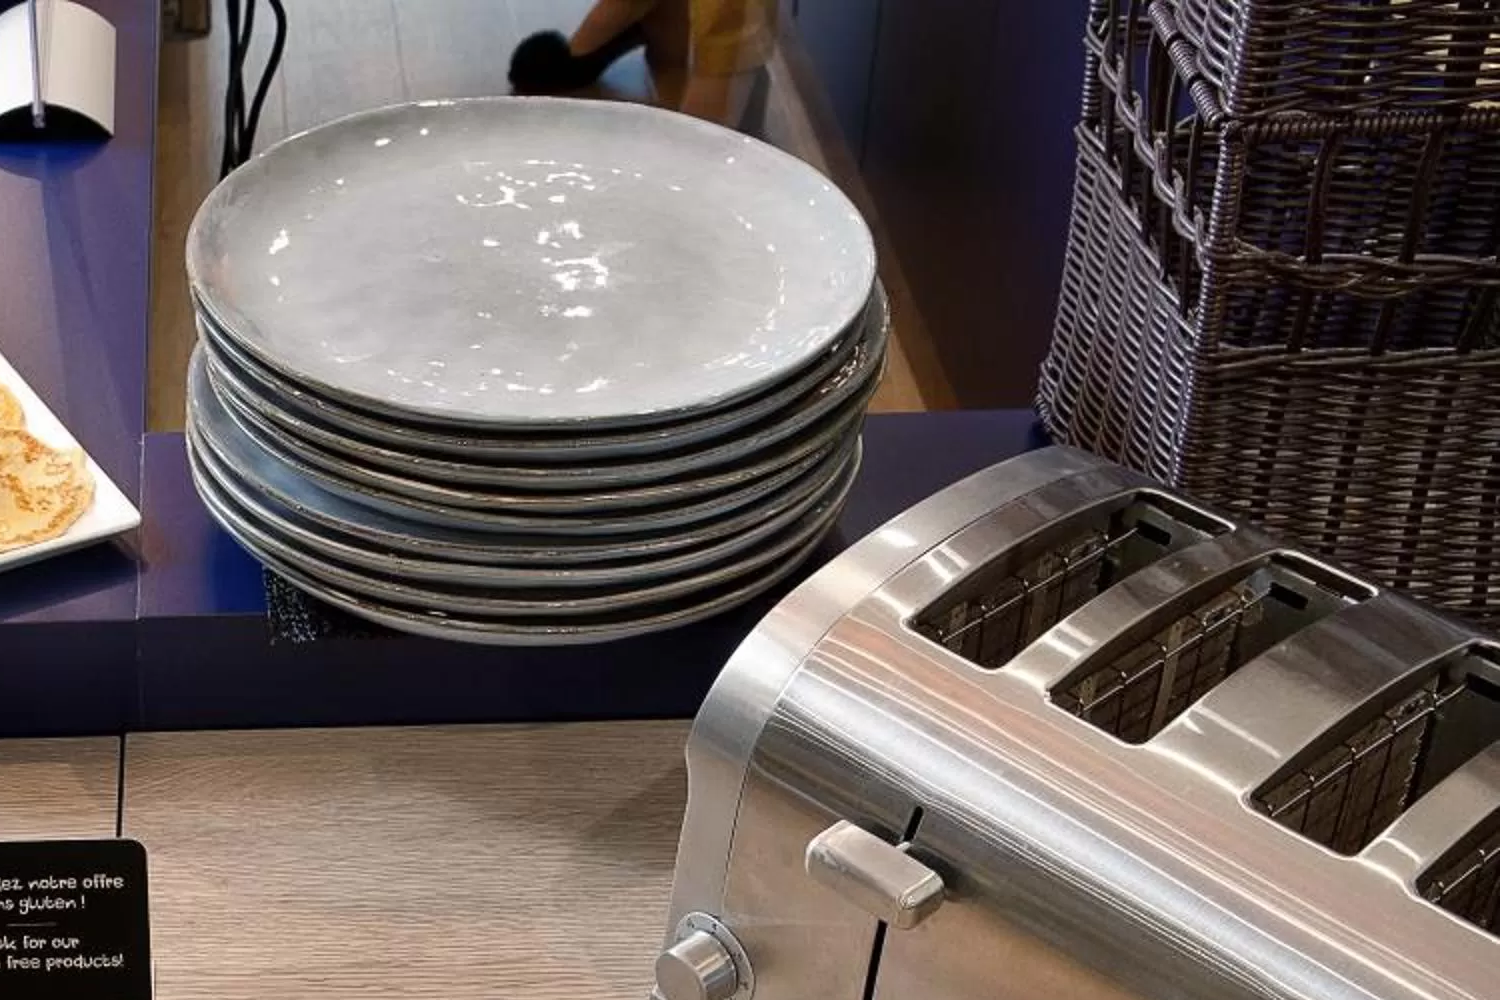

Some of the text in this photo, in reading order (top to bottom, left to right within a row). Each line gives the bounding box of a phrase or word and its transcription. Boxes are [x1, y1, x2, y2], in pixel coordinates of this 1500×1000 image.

[28, 875, 77, 890] notre
[82, 873, 125, 889] offre
[18, 895, 77, 915] gluten
[22, 935, 47, 950] for
[51, 937, 80, 949] our
[6, 954, 41, 969] free
[45, 953, 124, 972] products!
